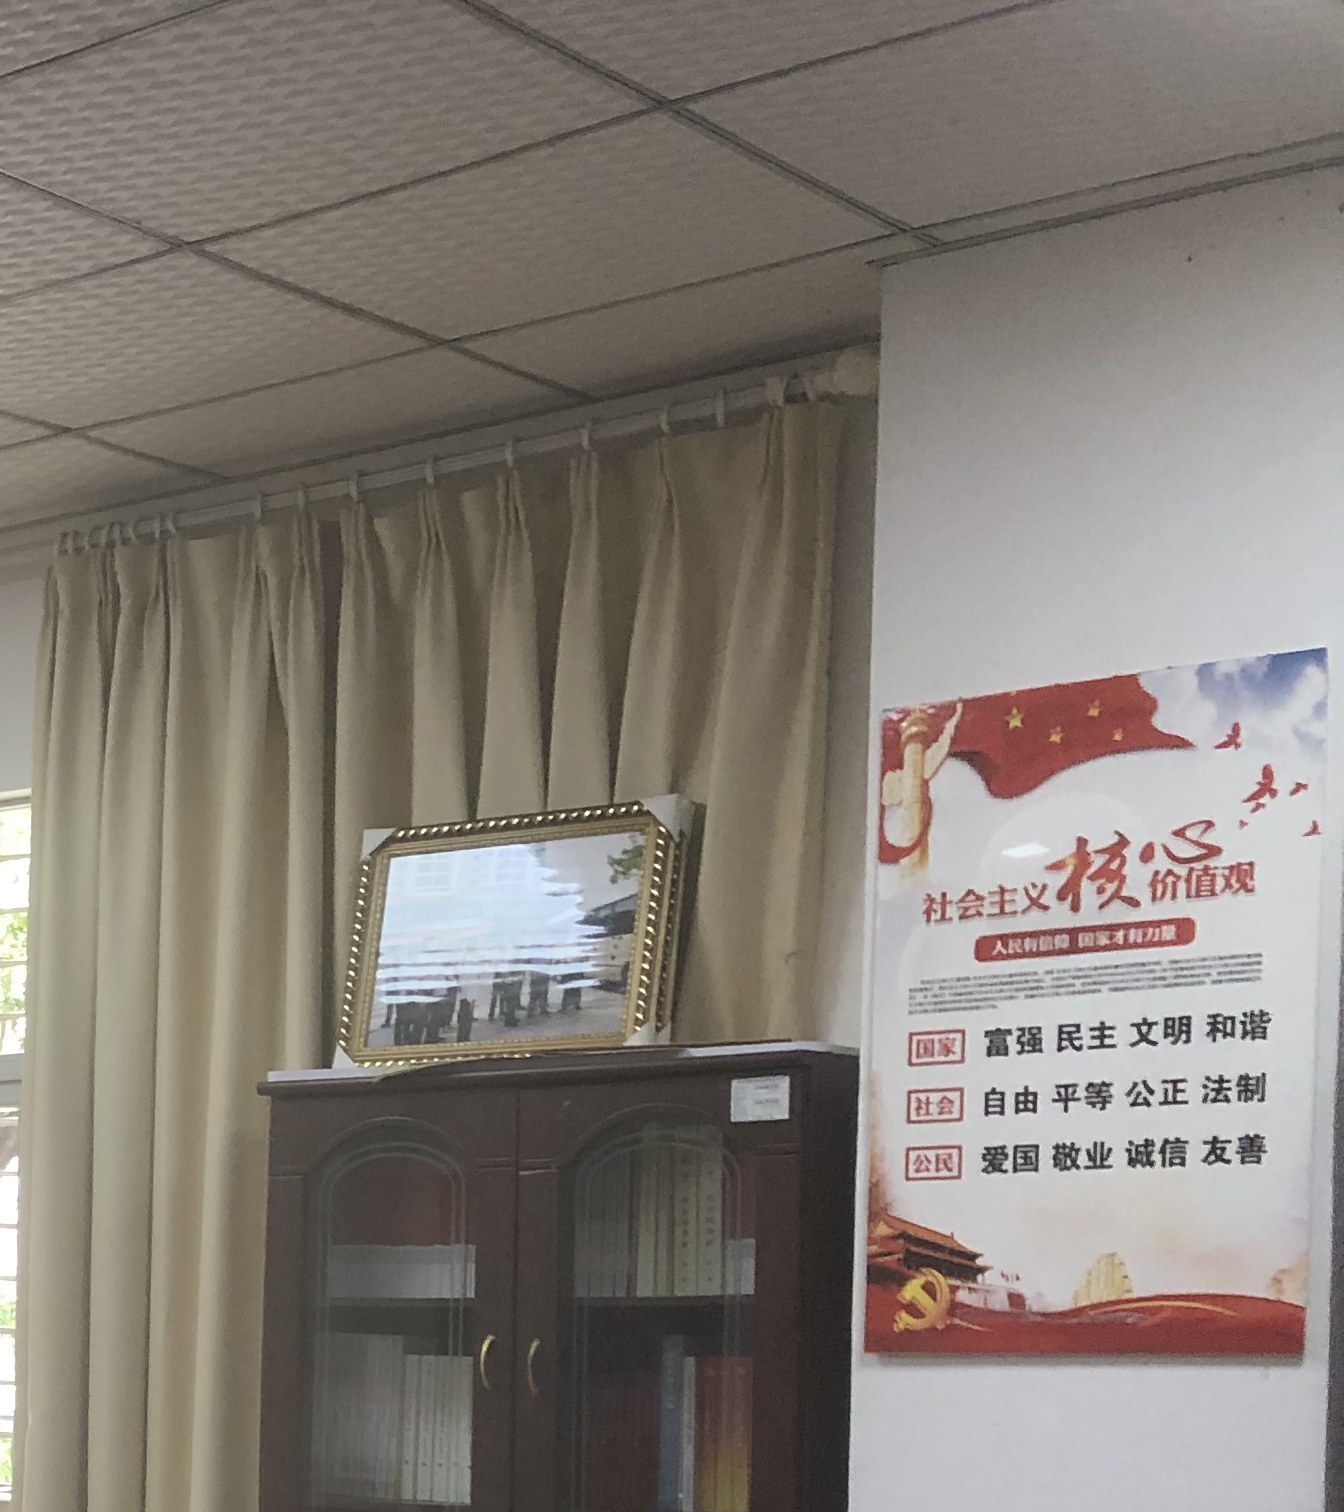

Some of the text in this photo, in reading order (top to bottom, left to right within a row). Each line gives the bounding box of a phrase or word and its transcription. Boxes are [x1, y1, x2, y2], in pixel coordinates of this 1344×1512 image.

[915, 1036, 957, 1060] 国家
[983, 1009, 1273, 1058] 富强 民主 文明 和谐
[914, 1095, 957, 1117] 社会
[983, 1072, 1267, 1118] 自由 平等 公正 法制
[912, 1152, 954, 1174] 公民
[981, 1133, 1269, 1175] 爱国 敬业 诚信 友善
